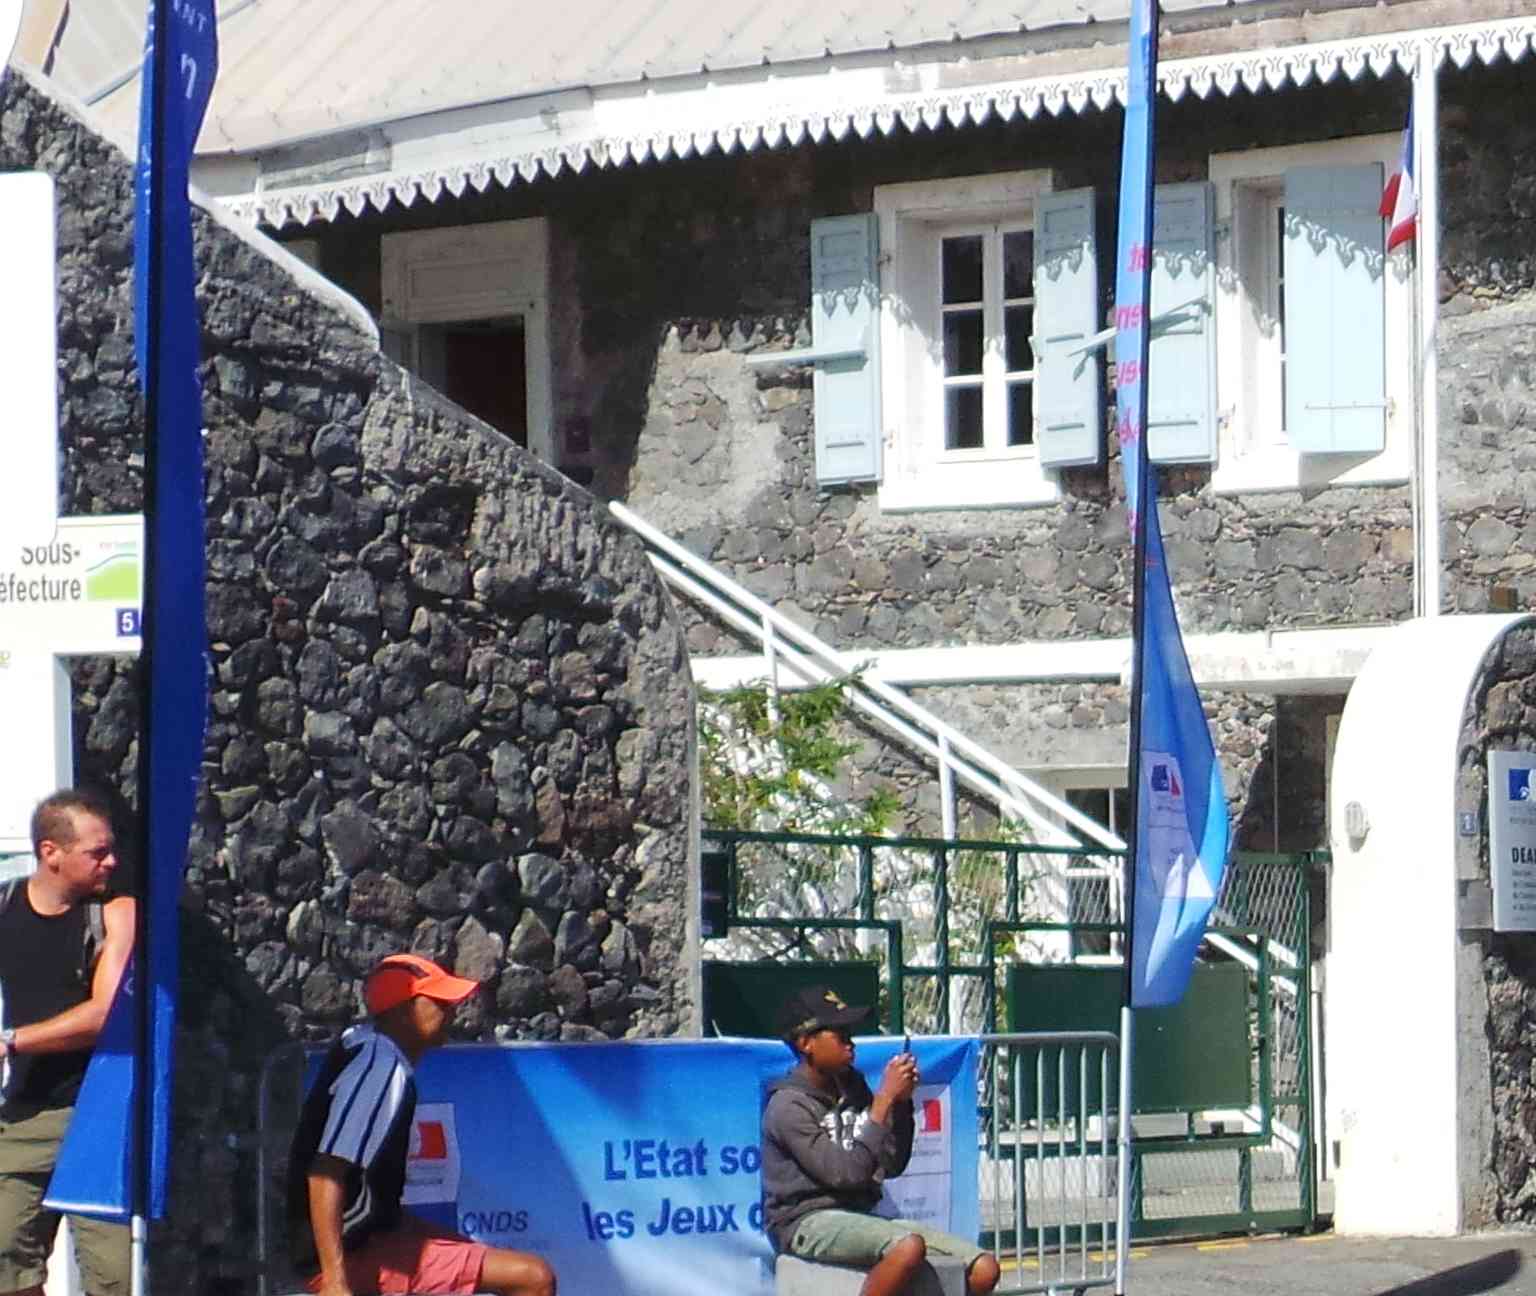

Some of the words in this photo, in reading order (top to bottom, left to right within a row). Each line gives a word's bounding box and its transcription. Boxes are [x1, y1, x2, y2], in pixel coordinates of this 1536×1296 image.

[603, 1137, 708, 1181] L'Etat
[461, 1210, 529, 1235] CNDS
[582, 1201, 635, 1241] les
[647, 1197, 739, 1238] Jeux
